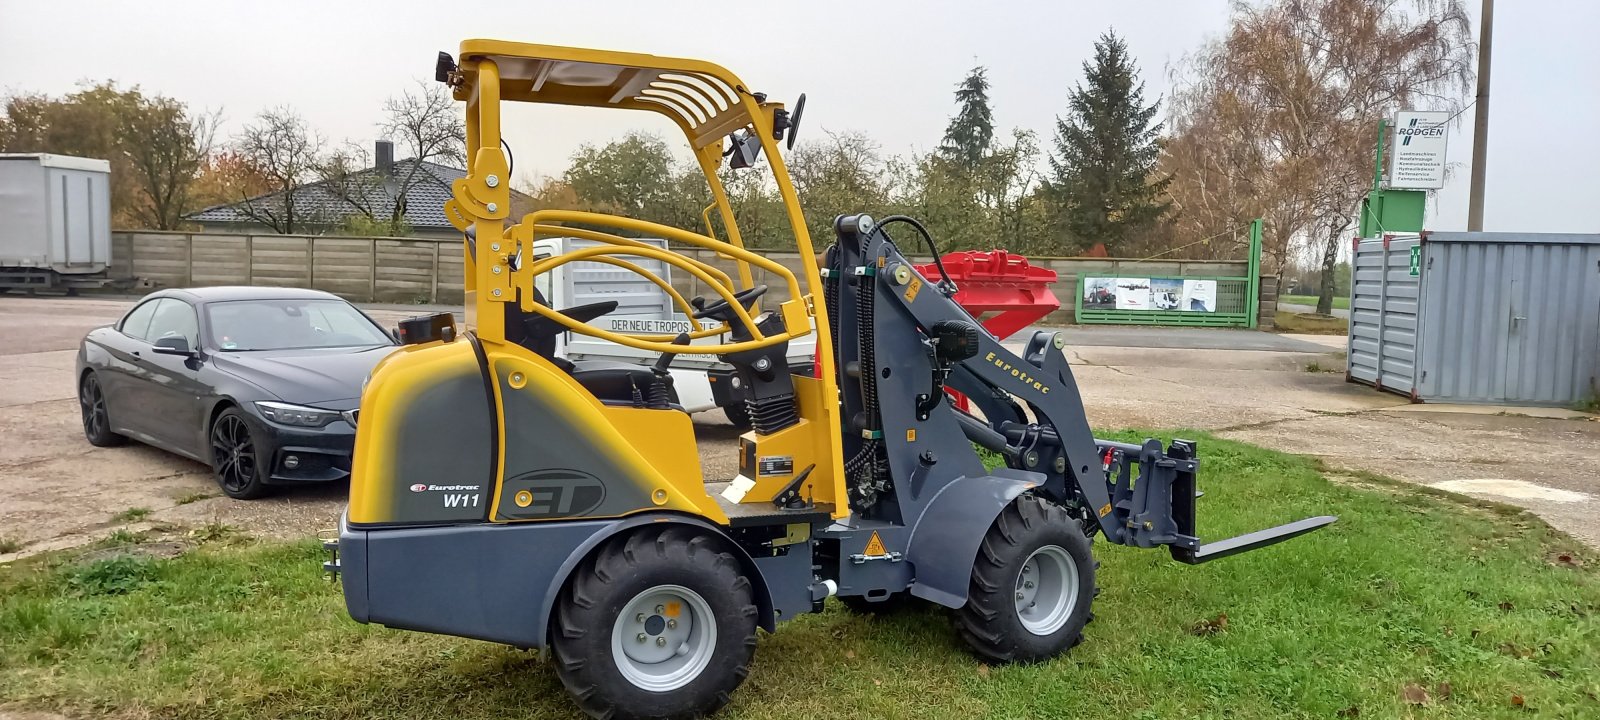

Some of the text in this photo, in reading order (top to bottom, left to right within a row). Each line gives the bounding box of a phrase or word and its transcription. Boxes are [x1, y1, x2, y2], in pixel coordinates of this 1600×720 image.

[612, 319, 628, 330] DER
[630, 320, 652, 332] NEUE
[654, 321, 689, 333] TROPOS
[985, 351, 1050, 394] Eurotrac
[443, 494, 480, 508] W11
